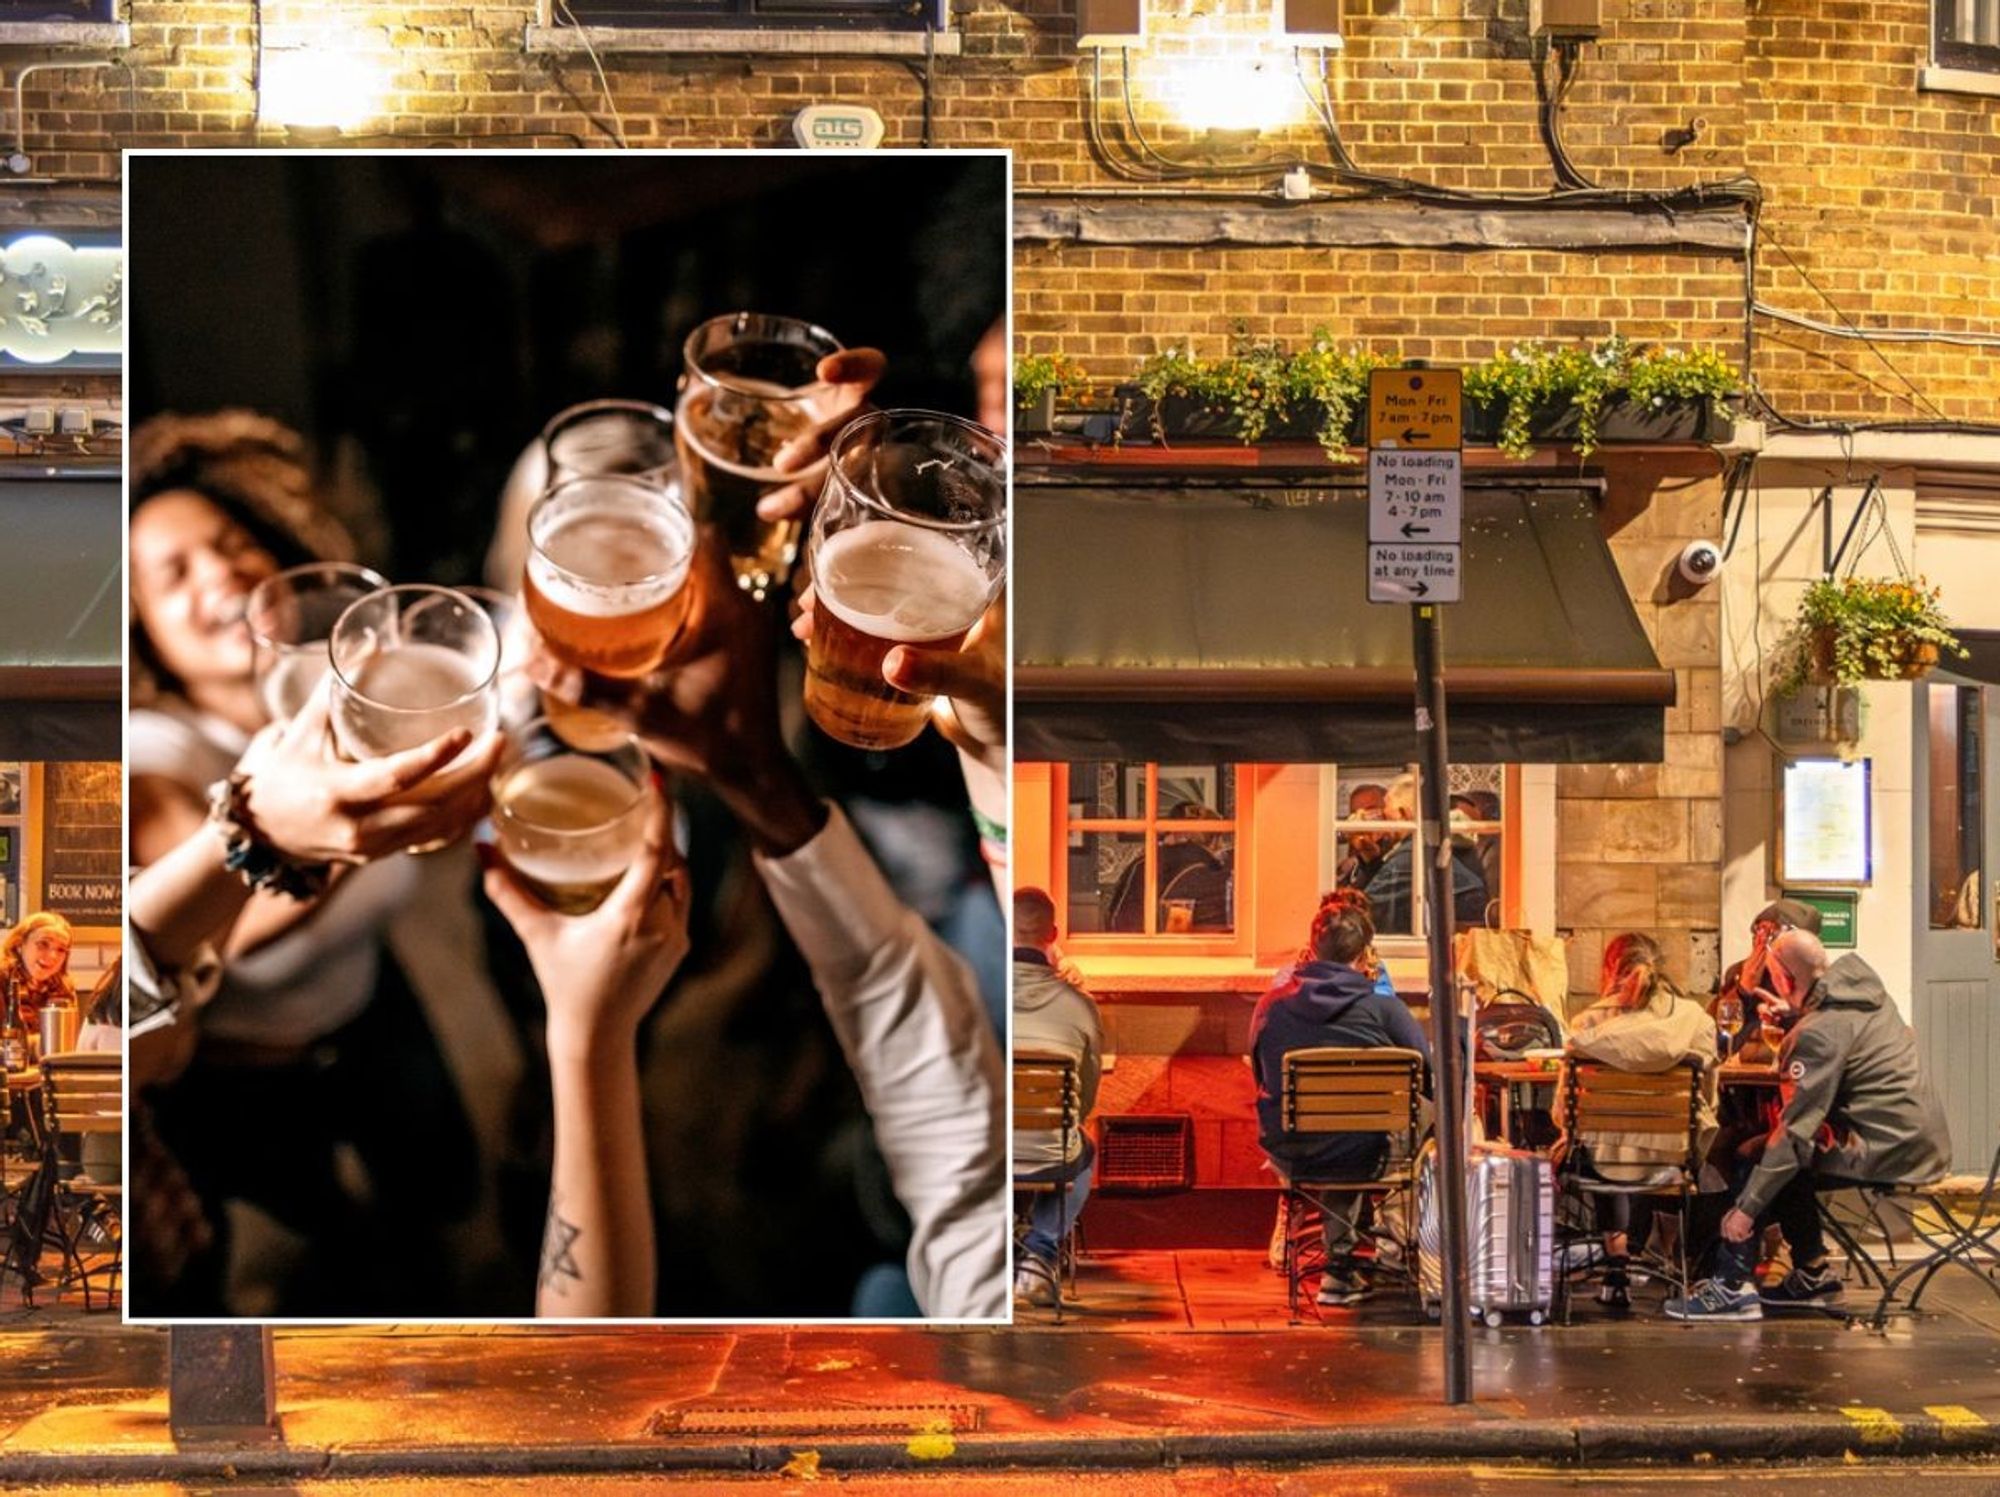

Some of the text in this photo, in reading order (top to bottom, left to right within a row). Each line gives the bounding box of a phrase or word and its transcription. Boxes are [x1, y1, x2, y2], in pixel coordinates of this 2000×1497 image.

[1385, 395, 1416, 406] Mon
[1428, 395, 1446, 406] Fri
[1377, 455, 1454, 469] No loading
[1385, 474, 1416, 485] Mon
[1428, 474, 1446, 486] Fri
[1385, 491, 1393, 502] 7
[1405, 491, 1420, 502] 10
[1424, 493, 1445, 502] am
[1388, 506, 1397, 516] 4
[1376, 549, 1453, 563] No loading
[1375, 565, 1455, 578] at any time
[49, 884, 83, 900] BOOK
[84, 884, 116, 900] NOW
